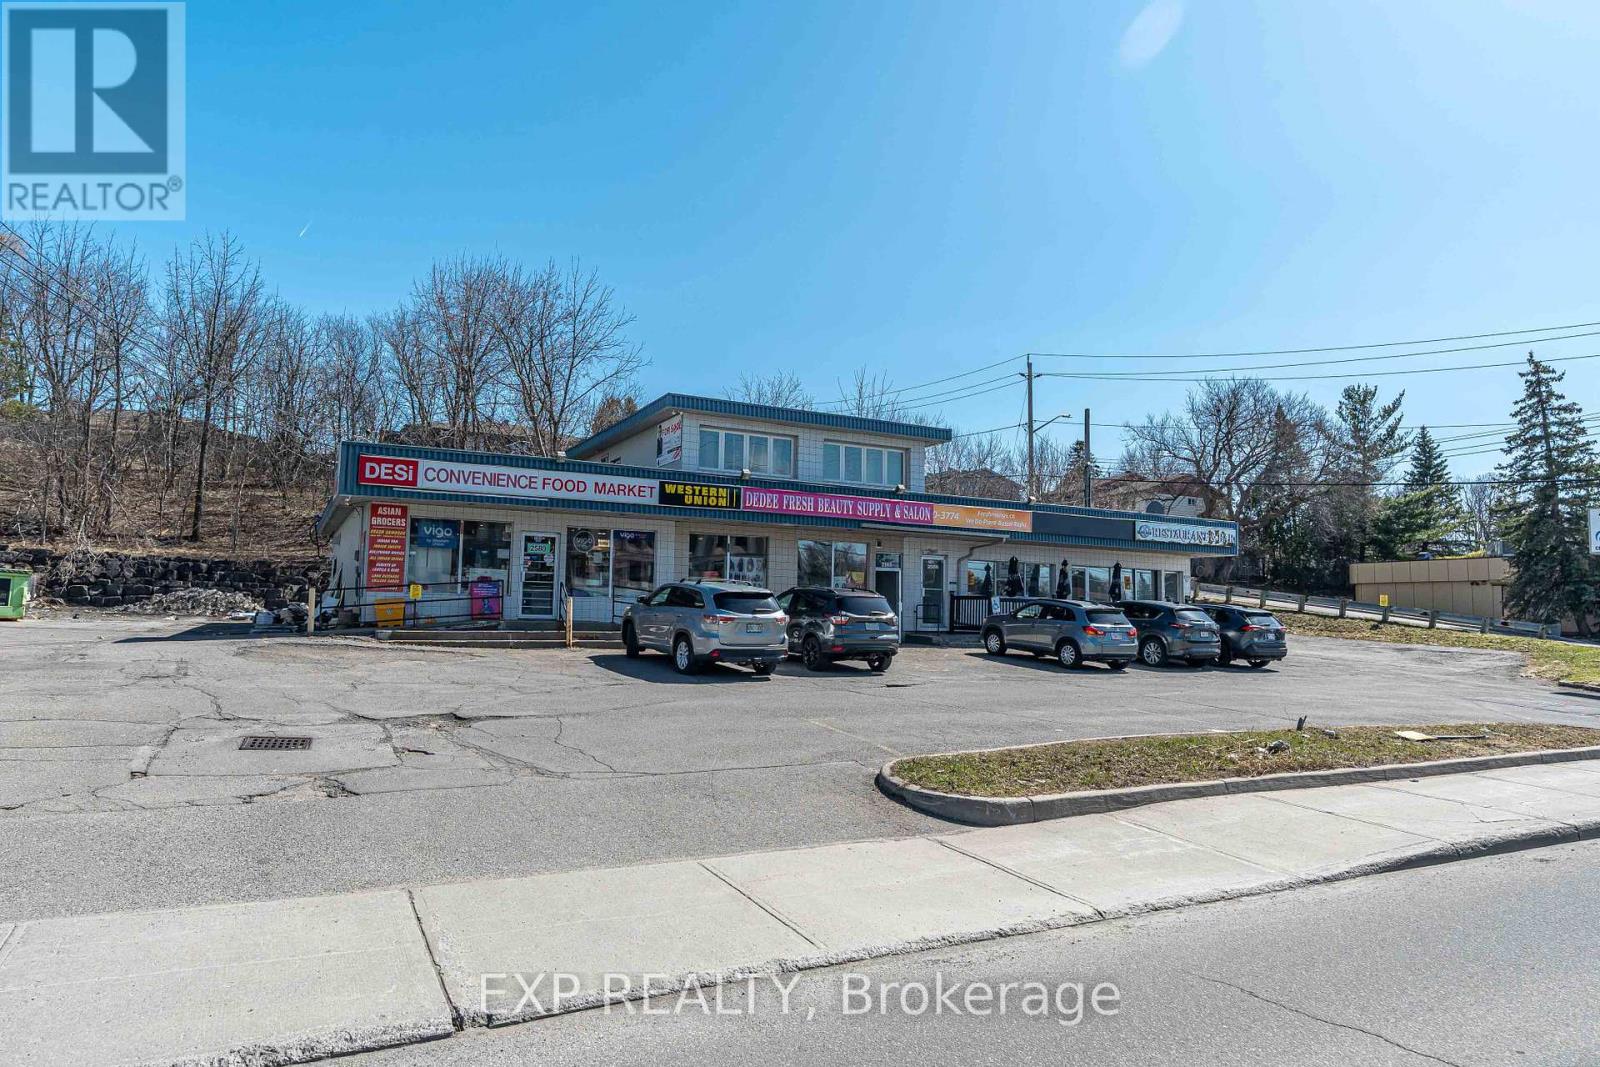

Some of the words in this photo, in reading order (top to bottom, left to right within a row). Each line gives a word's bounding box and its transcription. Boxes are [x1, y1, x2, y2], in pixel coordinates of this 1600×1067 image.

[424, 467, 538, 490] CONVENIENCE
[542, 477, 587, 493] FOOD
[594, 482, 656, 498] MARKET
[664, 483, 727, 497] WESTERN
[684, 495, 727, 507] UNION
[745, 491, 779, 509] DEDEE
[783, 494, 815, 512] FRESH
[818, 497, 855, 515] BEAUTY
[857, 501, 892, 518] SUPPLY
[894, 503, 901, 519] &
[903, 505, 932, 521] SALON
[377, 506, 402, 516] ASIAN
[371, 516, 406, 527] GROCERS
